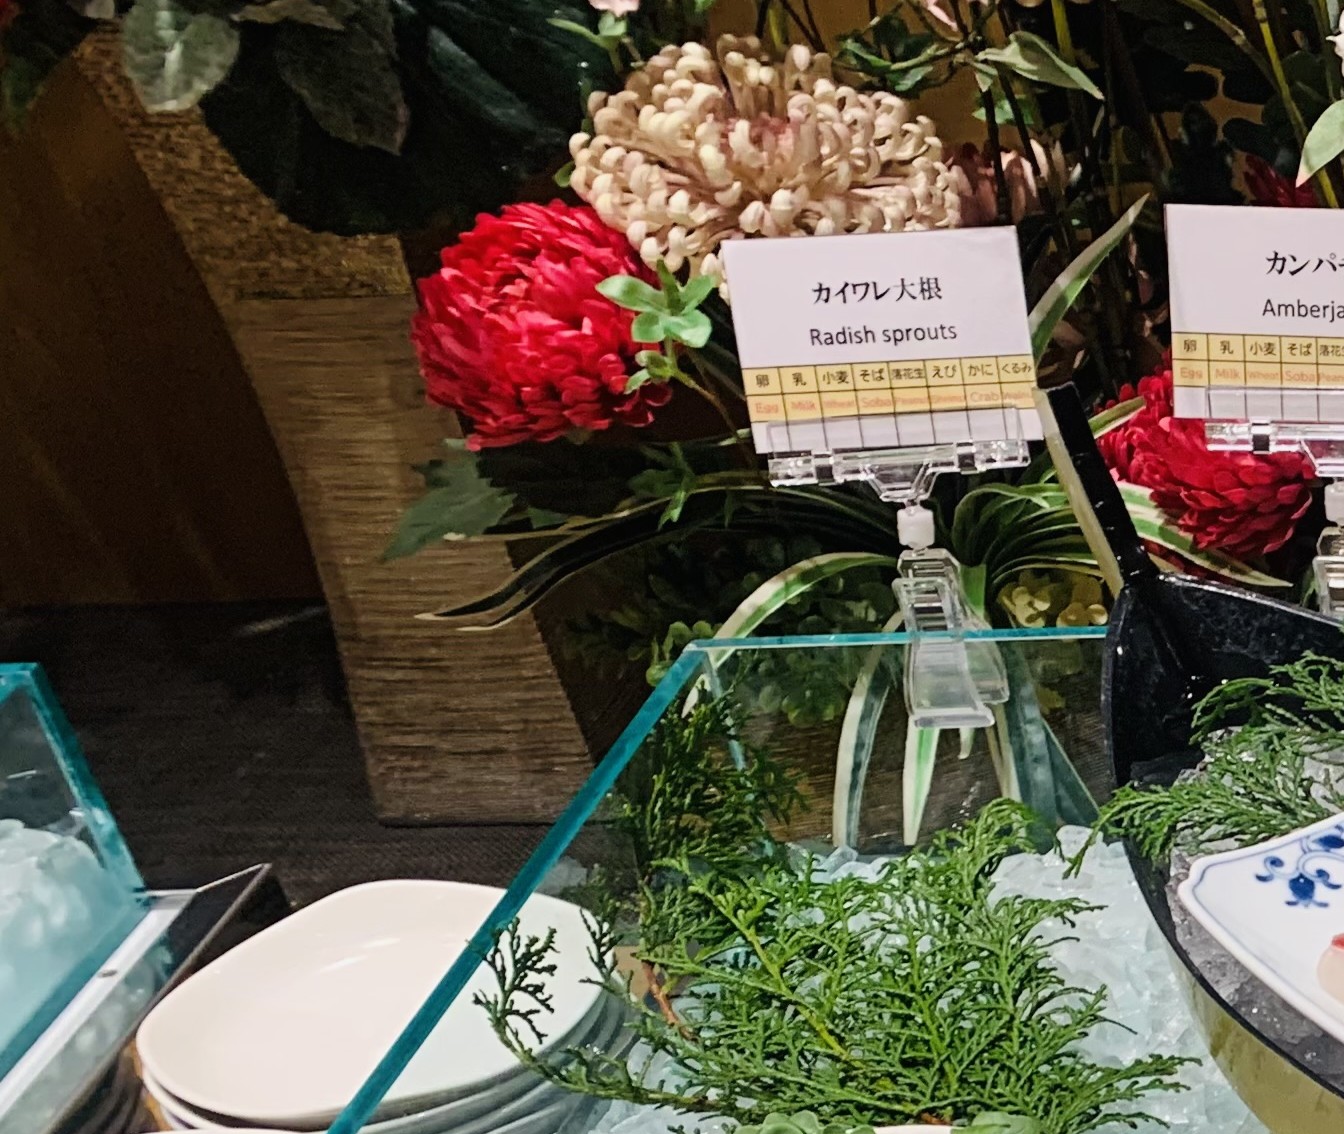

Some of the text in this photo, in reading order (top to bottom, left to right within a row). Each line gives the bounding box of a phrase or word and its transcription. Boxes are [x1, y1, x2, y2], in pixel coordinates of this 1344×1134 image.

[812, 277, 943, 304] カイワレ大根
[810, 322, 957, 347] Radish sprouts
[1183, 339, 1197, 352] 卵
[1220, 341, 1234, 354] 乳
[1250, 342, 1276, 356] 小麦
[1287, 343, 1313, 357] そば
[792, 372, 806, 386] 乳
[822, 371, 850, 385] 小麦
[859, 369, 884, 382] そば
[932, 365, 957, 378] えび
[968, 364, 993, 376] かに
[1180, 368, 1203, 380] Egg
[1216, 368, 1241, 380] Milk
[1285, 370, 1315, 382] Soba
